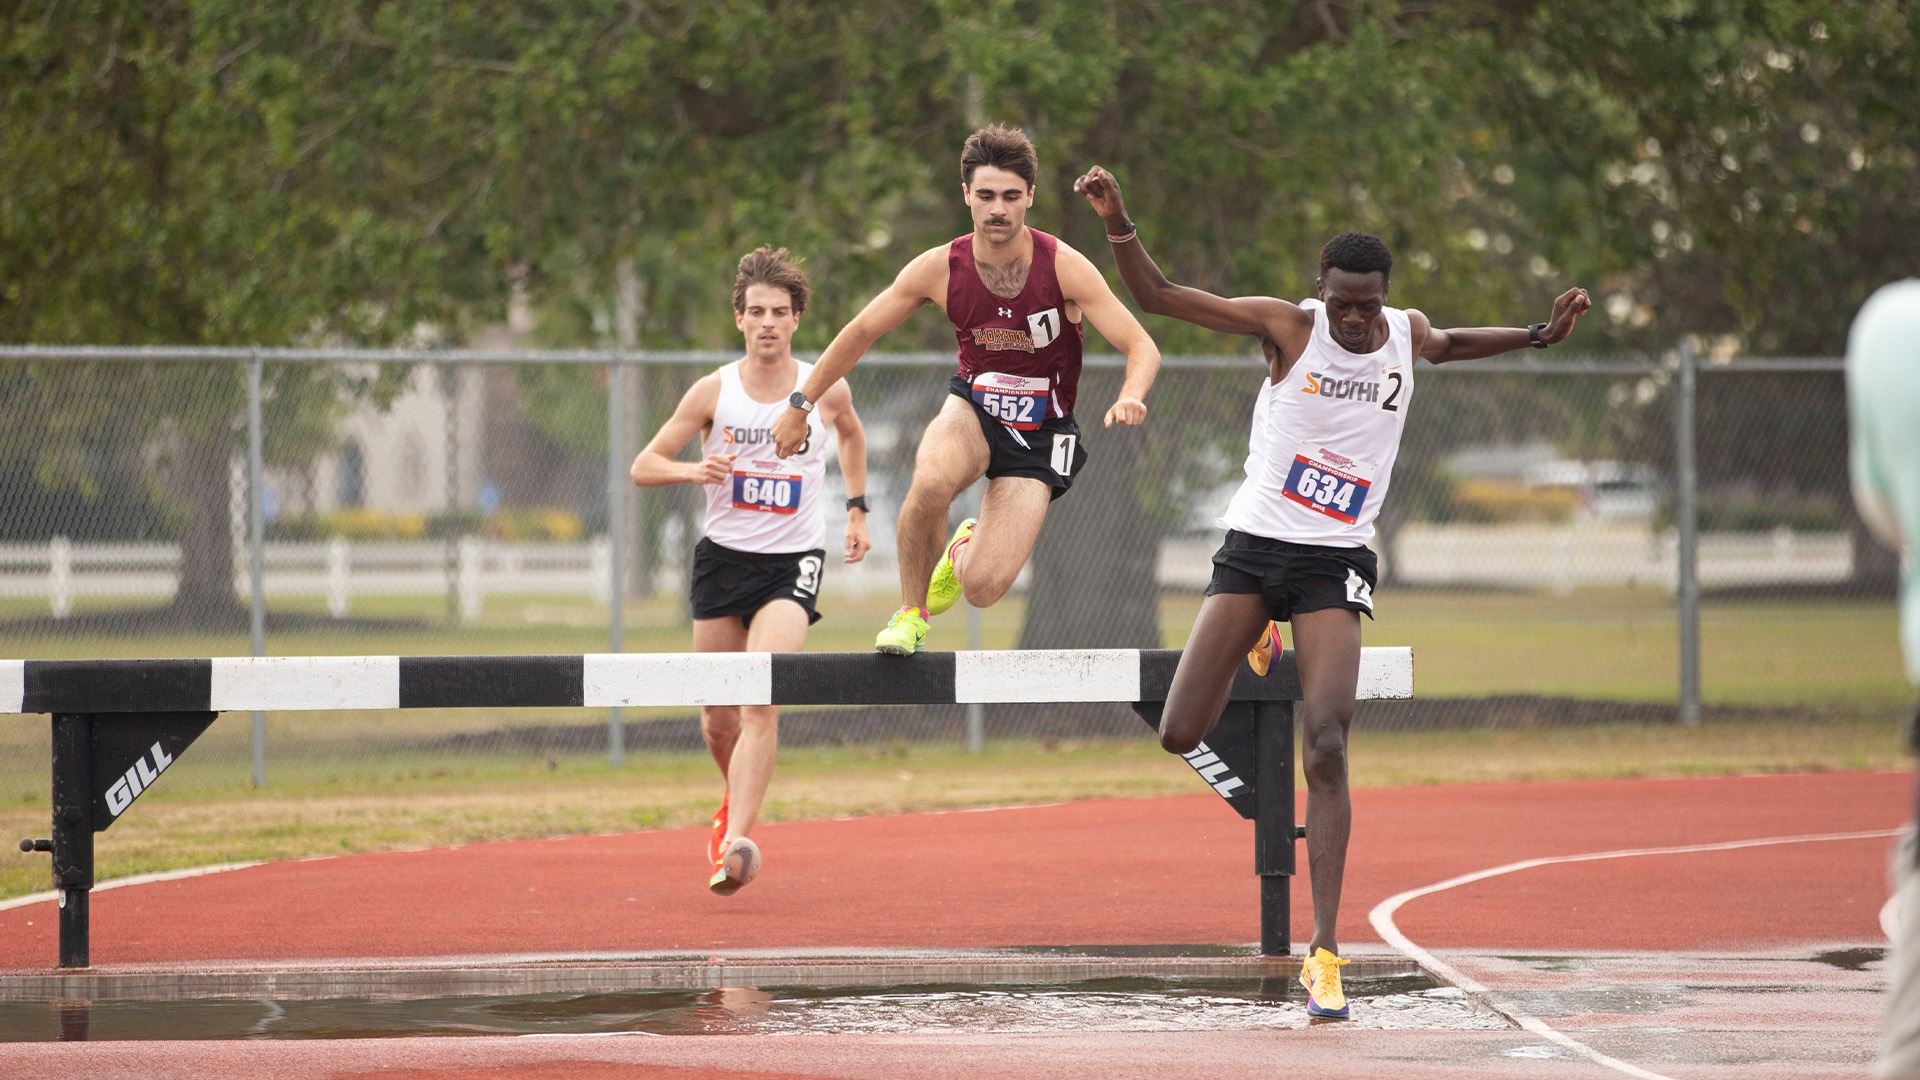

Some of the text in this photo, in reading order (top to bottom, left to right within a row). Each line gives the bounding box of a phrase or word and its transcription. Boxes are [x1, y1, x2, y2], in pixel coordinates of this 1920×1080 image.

[1038, 314, 1053, 342] 1
[986, 387, 1034, 395] CHAMPIONSHIP
[1382, 372, 1402, 411] 2
[983, 393, 1035, 422] 552
[1060, 438, 1070, 473] 1
[1308, 460, 1358, 482] CHAMPIONSHIP
[743, 478, 791, 507] 640
[1297, 467, 1356, 512] 634
[803, 560, 816, 588] 3
[105, 741, 172, 816] GILL
